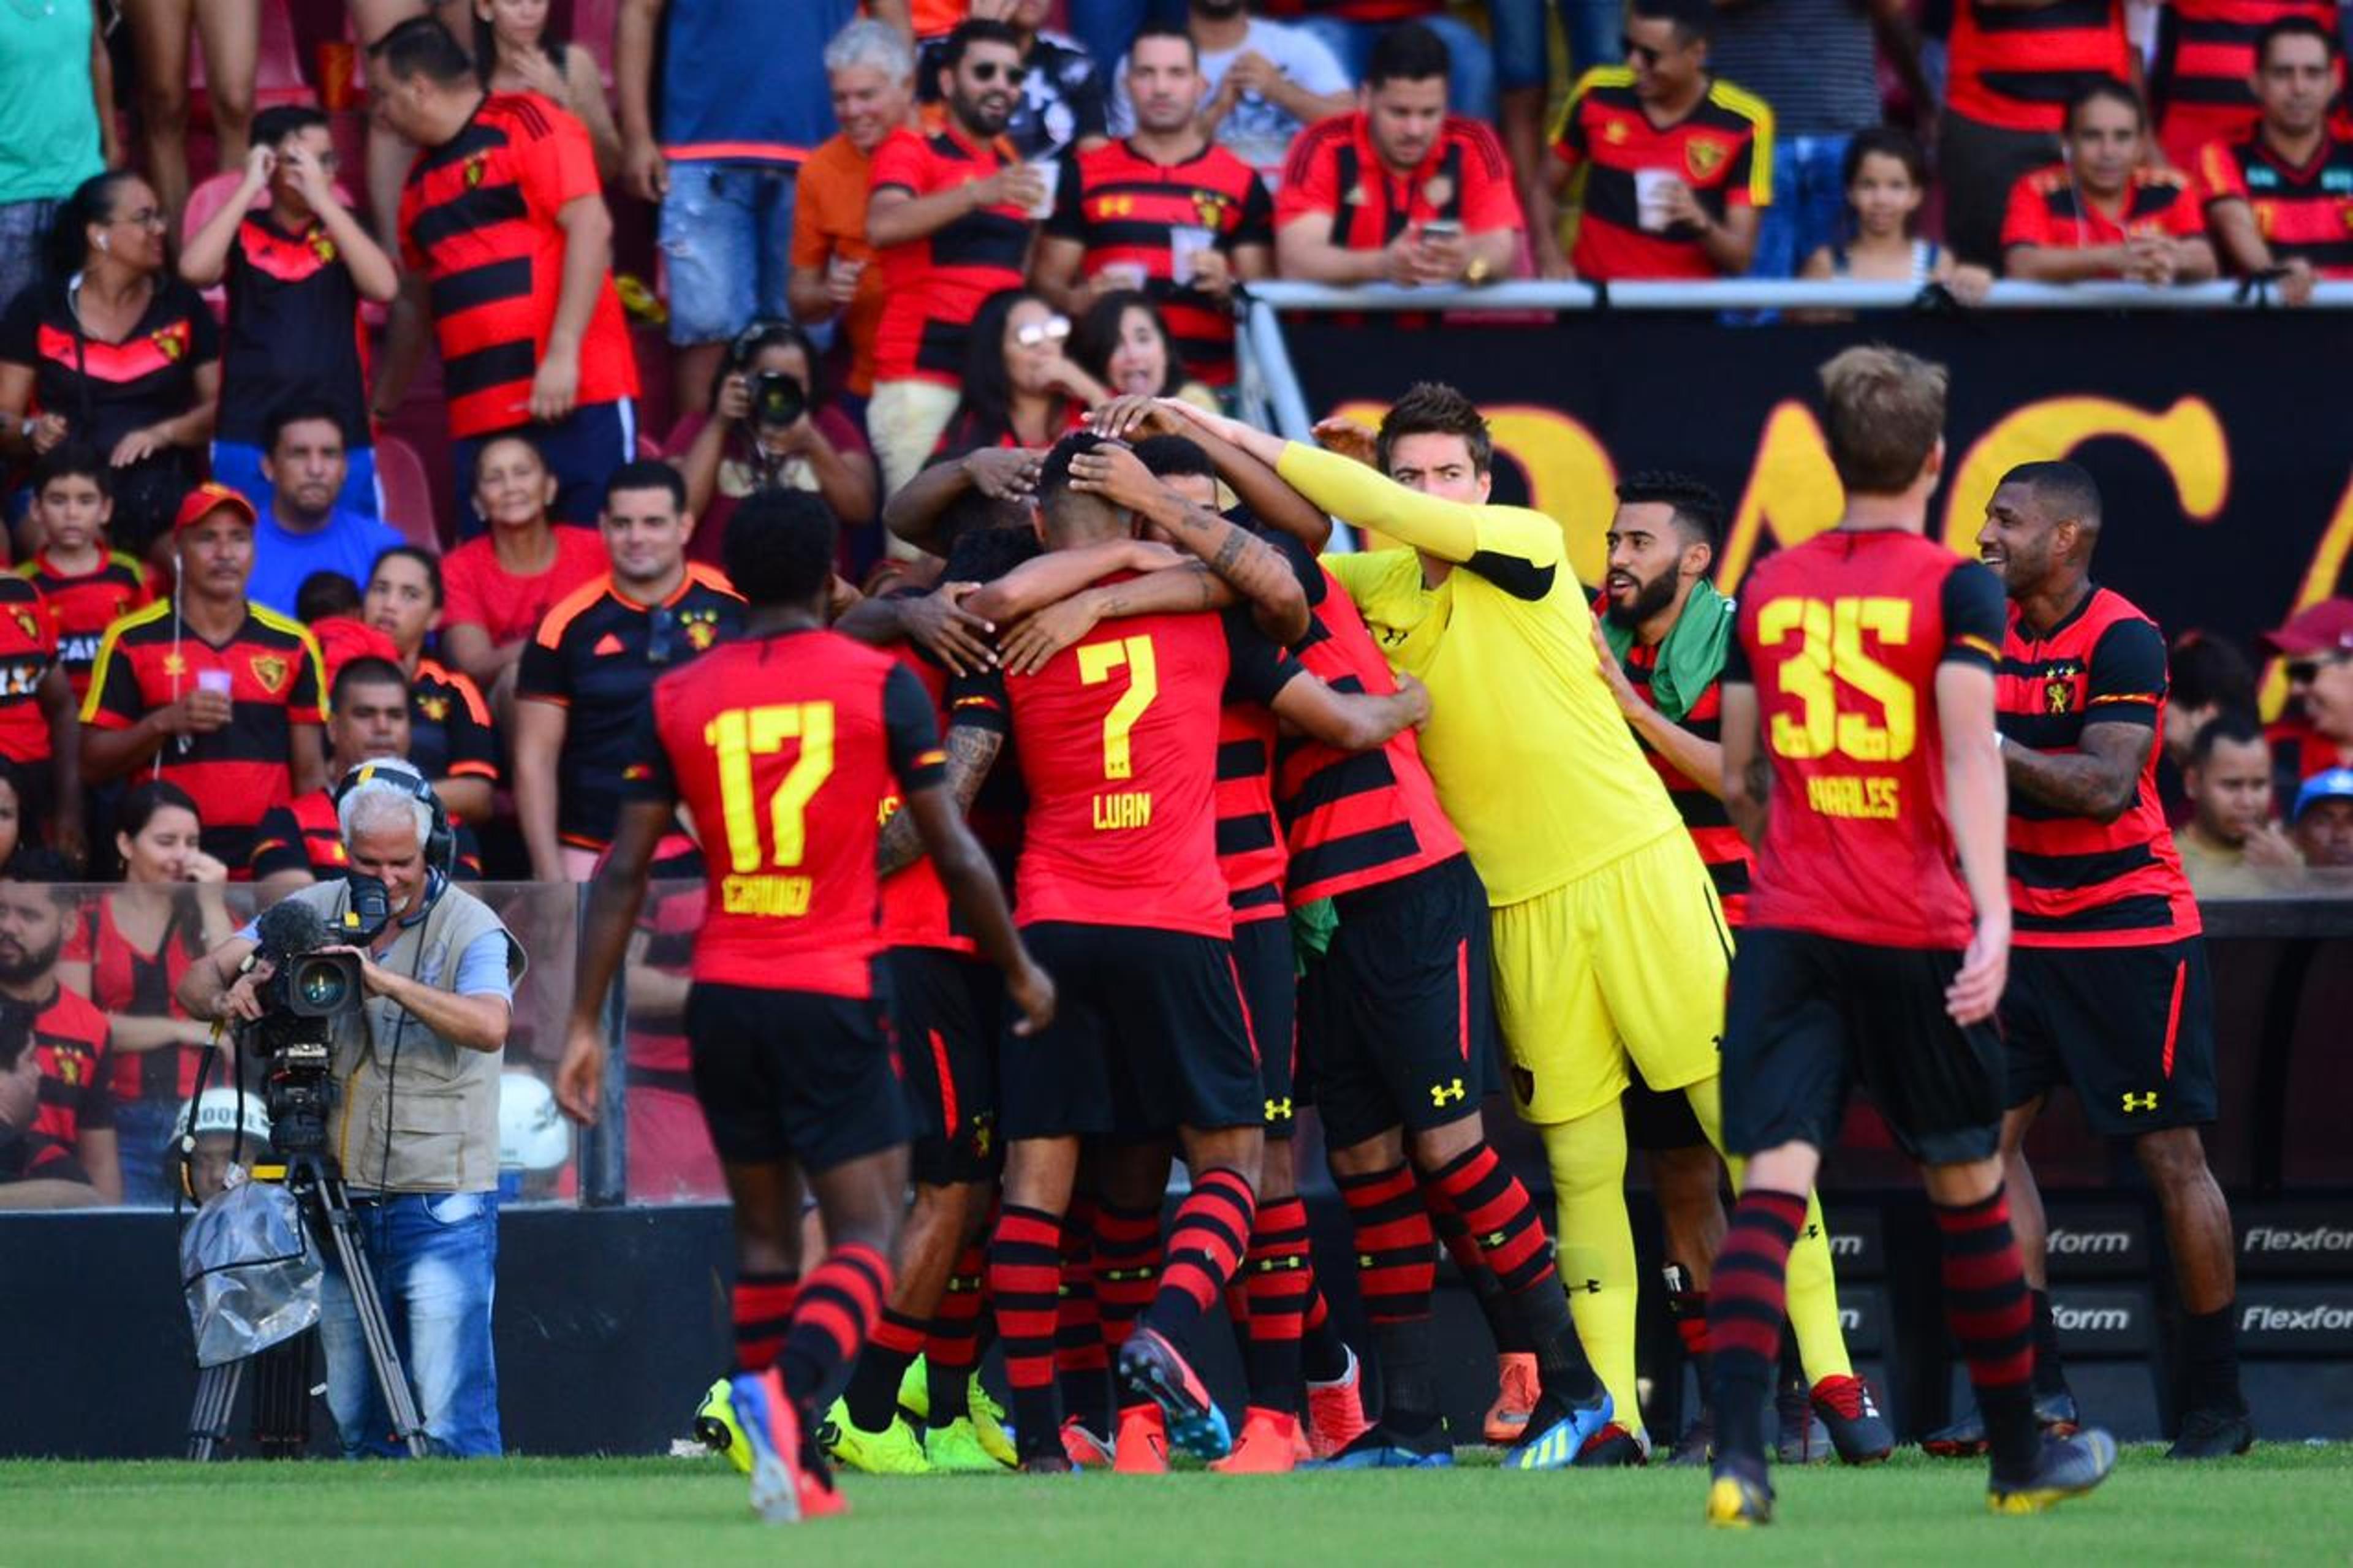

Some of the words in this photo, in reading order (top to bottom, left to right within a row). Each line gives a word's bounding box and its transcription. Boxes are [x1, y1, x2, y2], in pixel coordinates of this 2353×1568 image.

[1077, 634, 1158, 780] 7
[1757, 596, 1917, 762] 35
[705, 700, 835, 873] 17
[1094, 793, 1151, 830] LUAN
